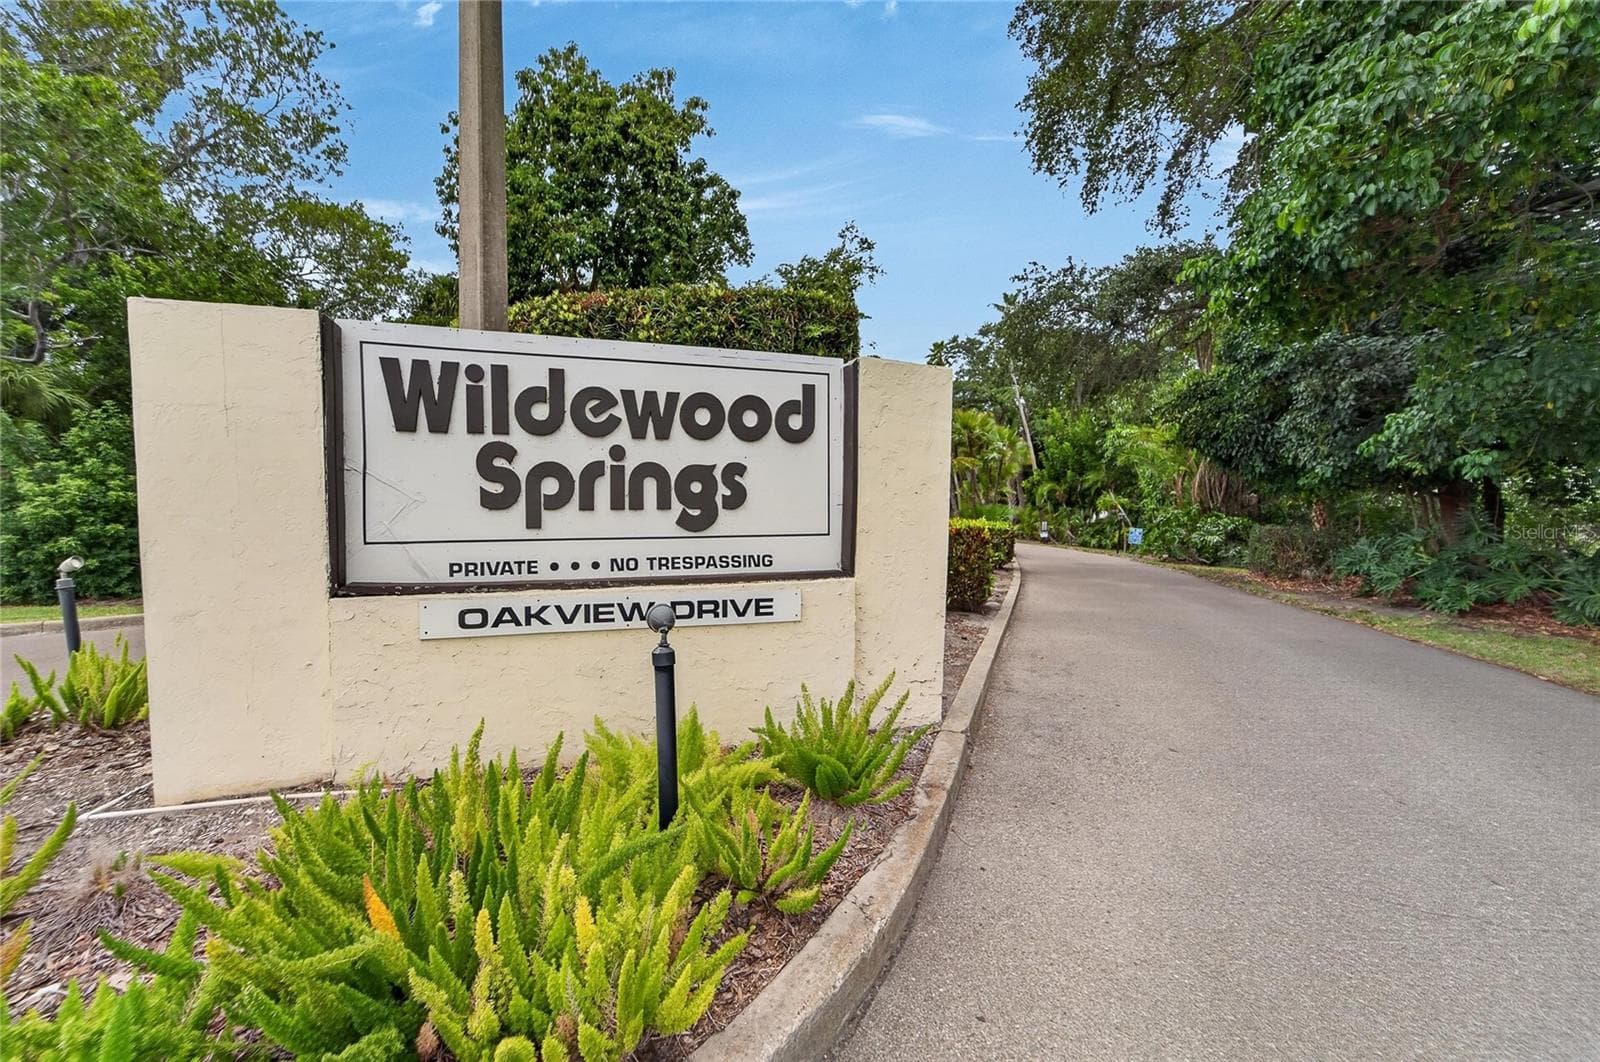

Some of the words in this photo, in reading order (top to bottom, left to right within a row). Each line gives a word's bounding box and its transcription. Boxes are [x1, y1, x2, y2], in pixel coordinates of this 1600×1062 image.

[379, 356, 815, 443] Wildewood
[476, 441, 748, 532] Springs
[448, 560, 538, 577] PRIVATE
[610, 557, 639, 571] NO
[646, 554, 773, 570] TRESPASSING
[458, 601, 655, 629] OAKVIEW
[671, 598, 774, 620] DRIVE
